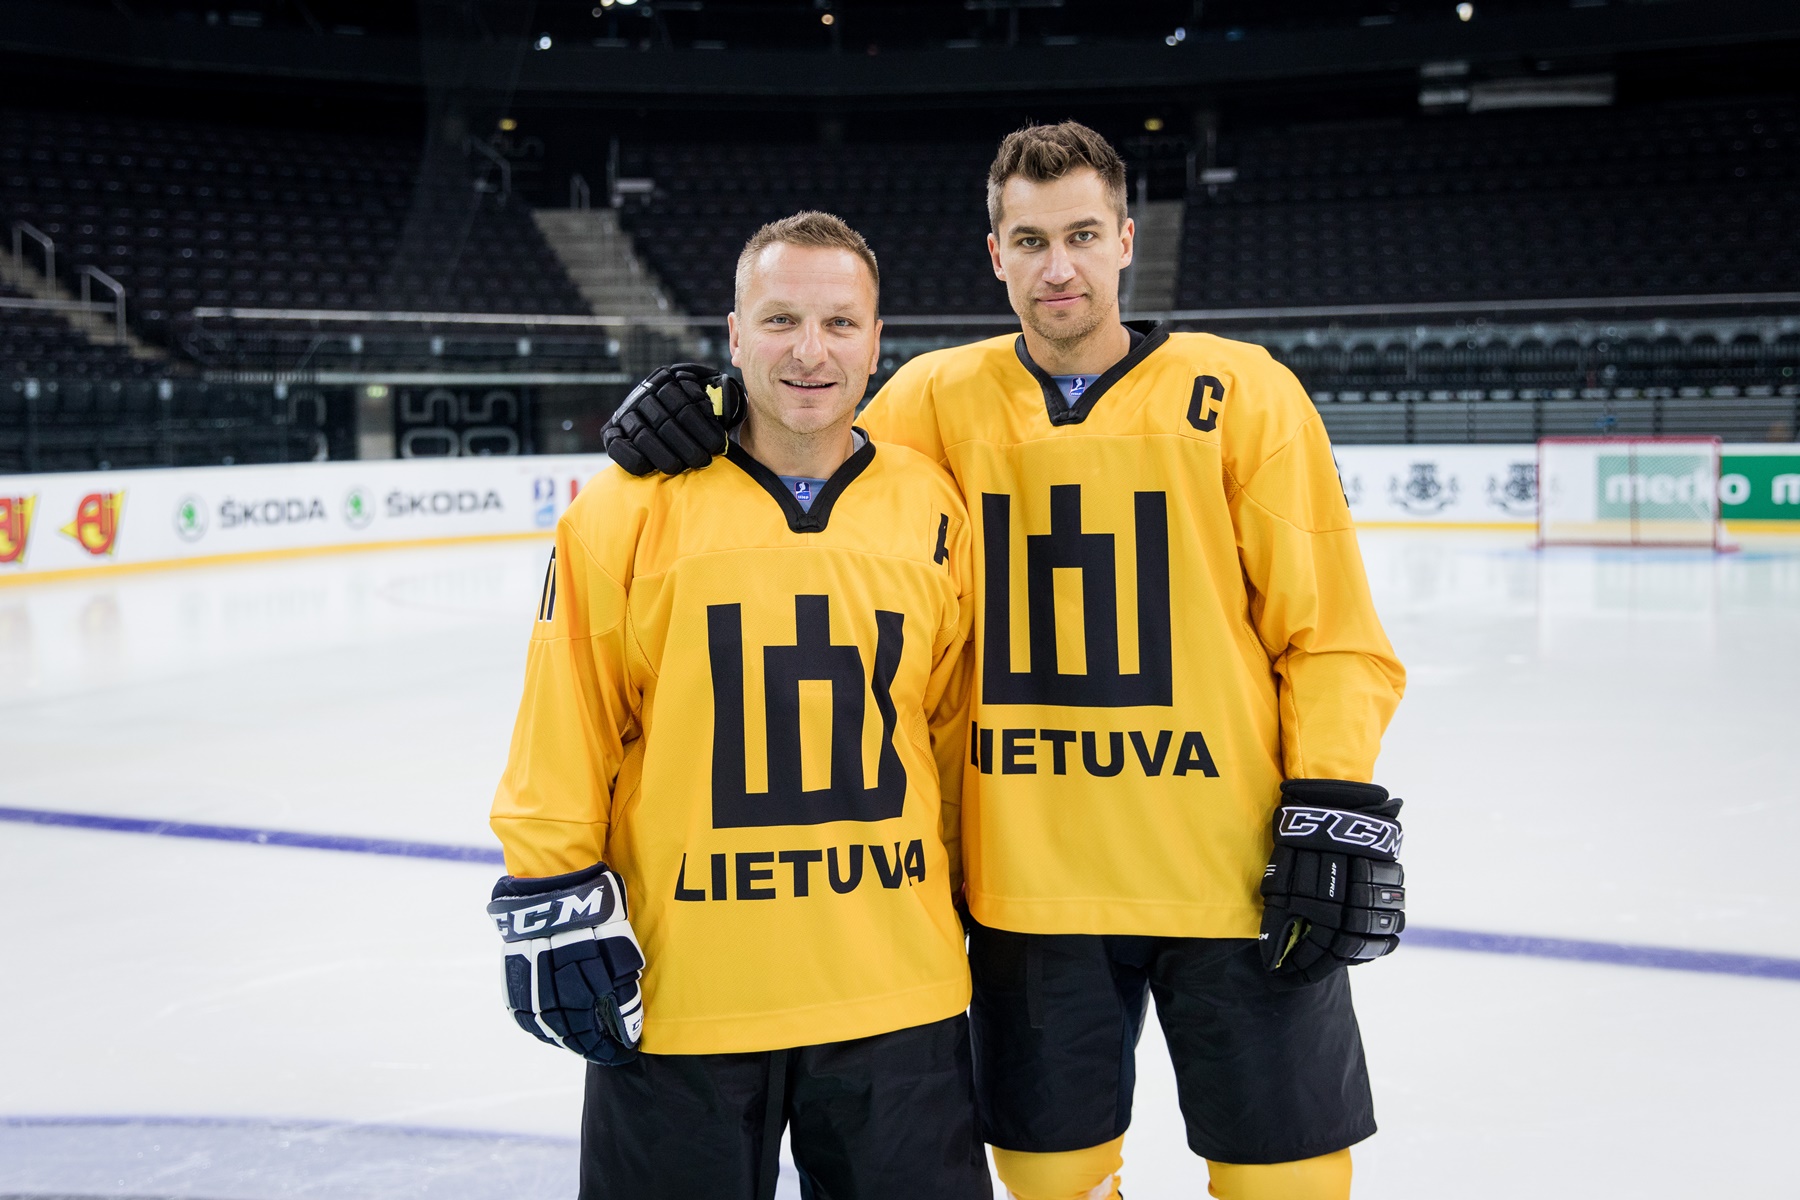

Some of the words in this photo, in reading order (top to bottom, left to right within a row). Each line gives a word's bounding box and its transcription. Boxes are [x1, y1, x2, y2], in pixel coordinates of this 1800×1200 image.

[1187, 375, 1225, 432] C
[220, 495, 326, 529] ŠKODA
[386, 488, 503, 518] ŠKODA
[1279, 806, 1404, 860] CCM
[674, 839, 926, 902] LIETUVA
